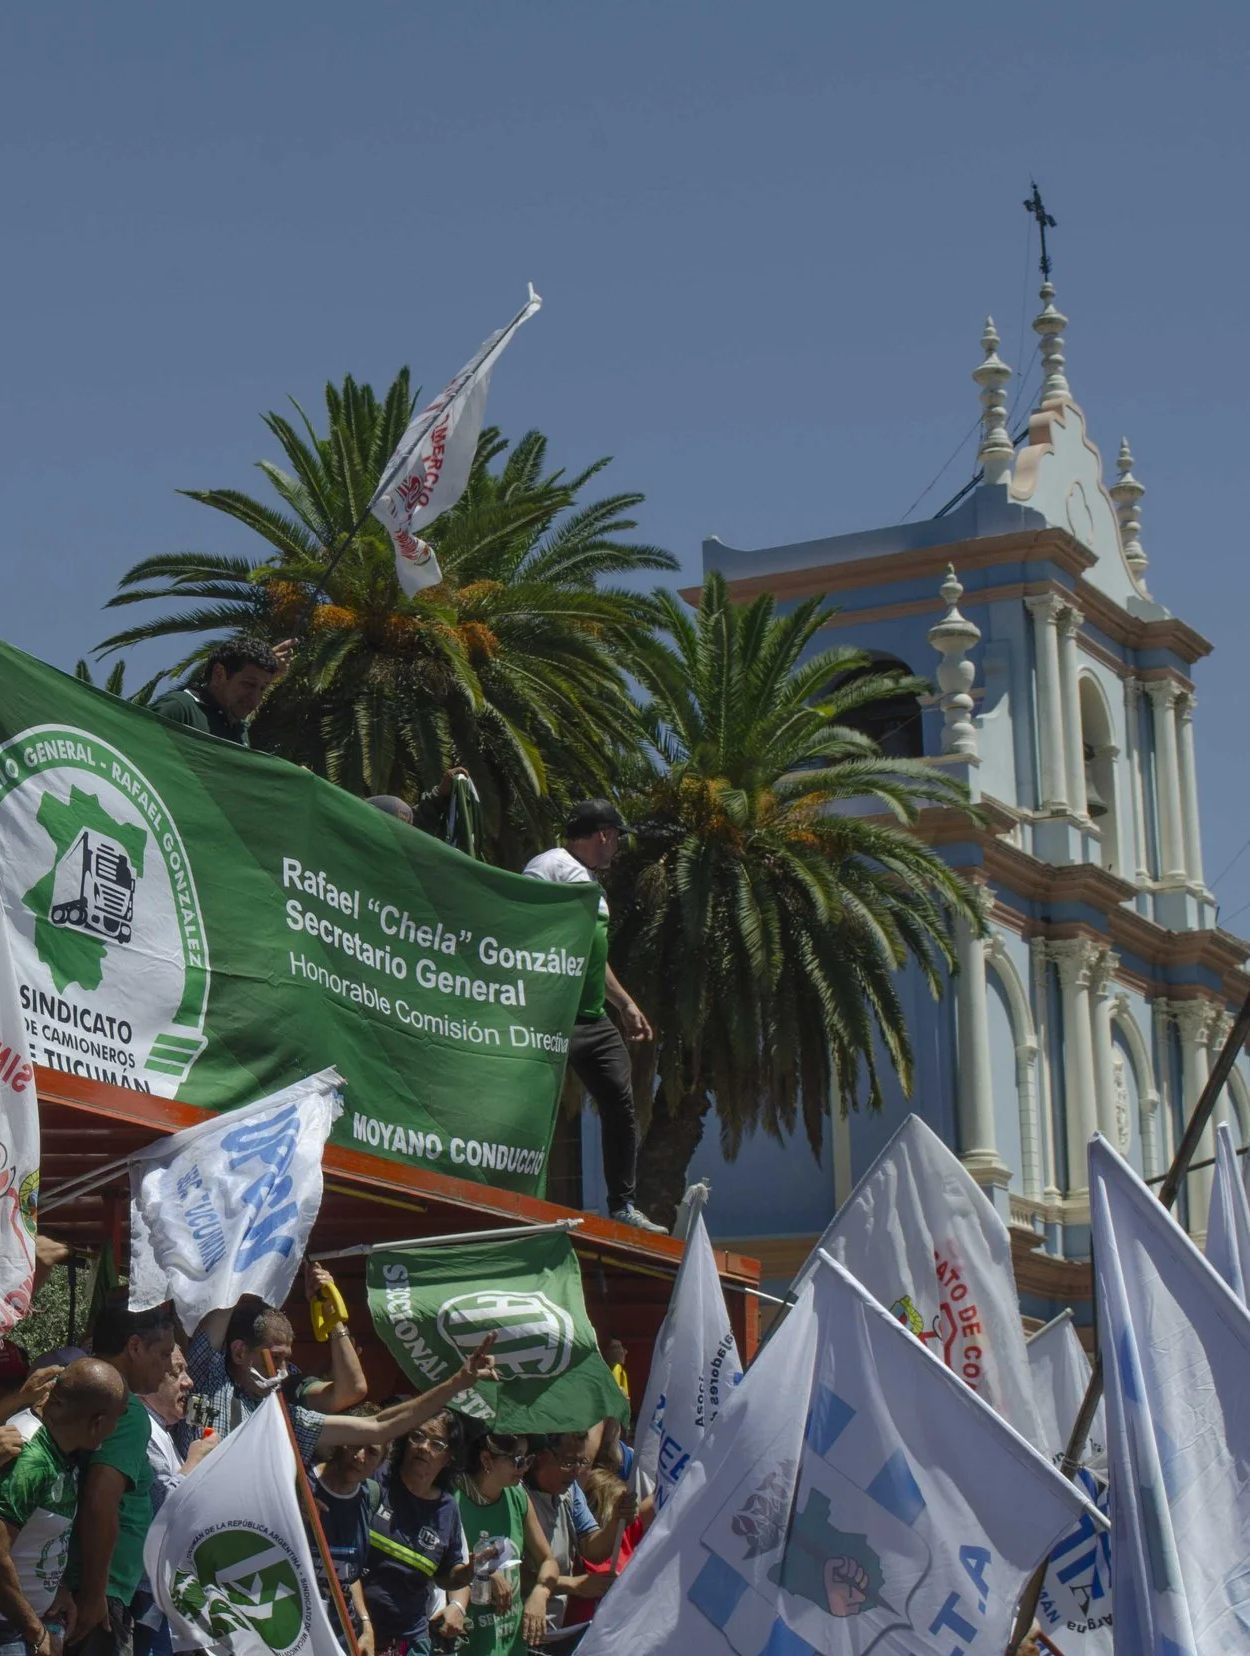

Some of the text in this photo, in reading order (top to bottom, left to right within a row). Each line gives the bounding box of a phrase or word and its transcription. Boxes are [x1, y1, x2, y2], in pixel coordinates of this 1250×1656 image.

[24, 739, 97, 768] GENERAL
[111, 761, 163, 832] RAFAEL
[162, 831, 202, 968] GONZÁLEZ
[282, 857, 360, 919] Rafael
[479, 936, 585, 977] González
[285, 899, 526, 1006] Secretario General
[19, 984, 133, 1045] SINDICATO
[289, 951, 569, 1053] Honorable Comisión Directiva
[41, 1027, 136, 1069] CAMIONEROS
[353, 1112, 443, 1160] MOYANO
[933, 1250, 969, 1301] ATO
[958, 1304, 982, 1339] DE
[204, 1525, 216, 1535] DE
[216, 1521, 226, 1530] LA
[227, 1518, 269, 1535] REPÚBLICA
[268, 1530, 302, 1569] ARGENTINA
[301, 1578, 313, 1622] SINDICATO
